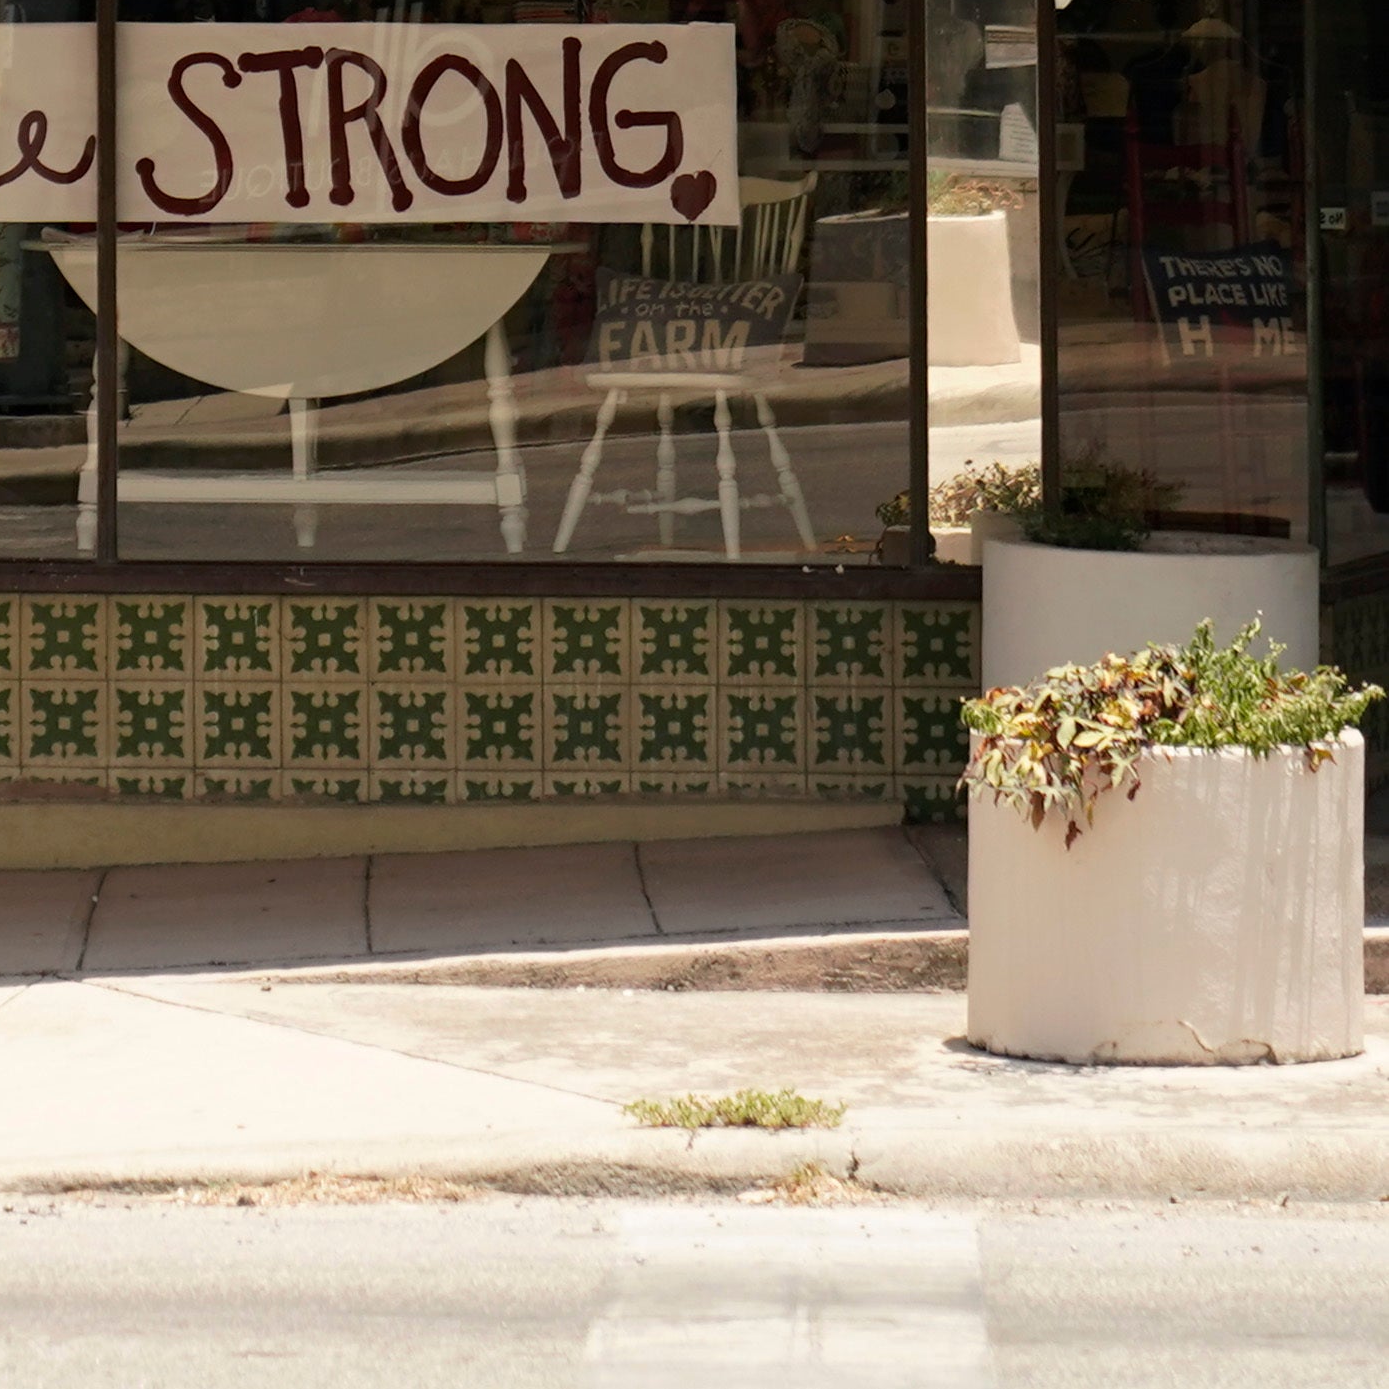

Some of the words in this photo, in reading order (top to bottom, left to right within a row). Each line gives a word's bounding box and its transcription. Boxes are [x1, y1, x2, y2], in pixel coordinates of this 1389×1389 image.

[1159, 255, 1251, 279] THERE'S
[1252, 255, 1283, 277] NO
[1167, 282, 1248, 308] PLACE
[1250, 282, 1288, 308] LIKE
[634, 301, 666, 317] on
[675, 299, 714, 318] the
[599, 318, 751, 372] FARM
